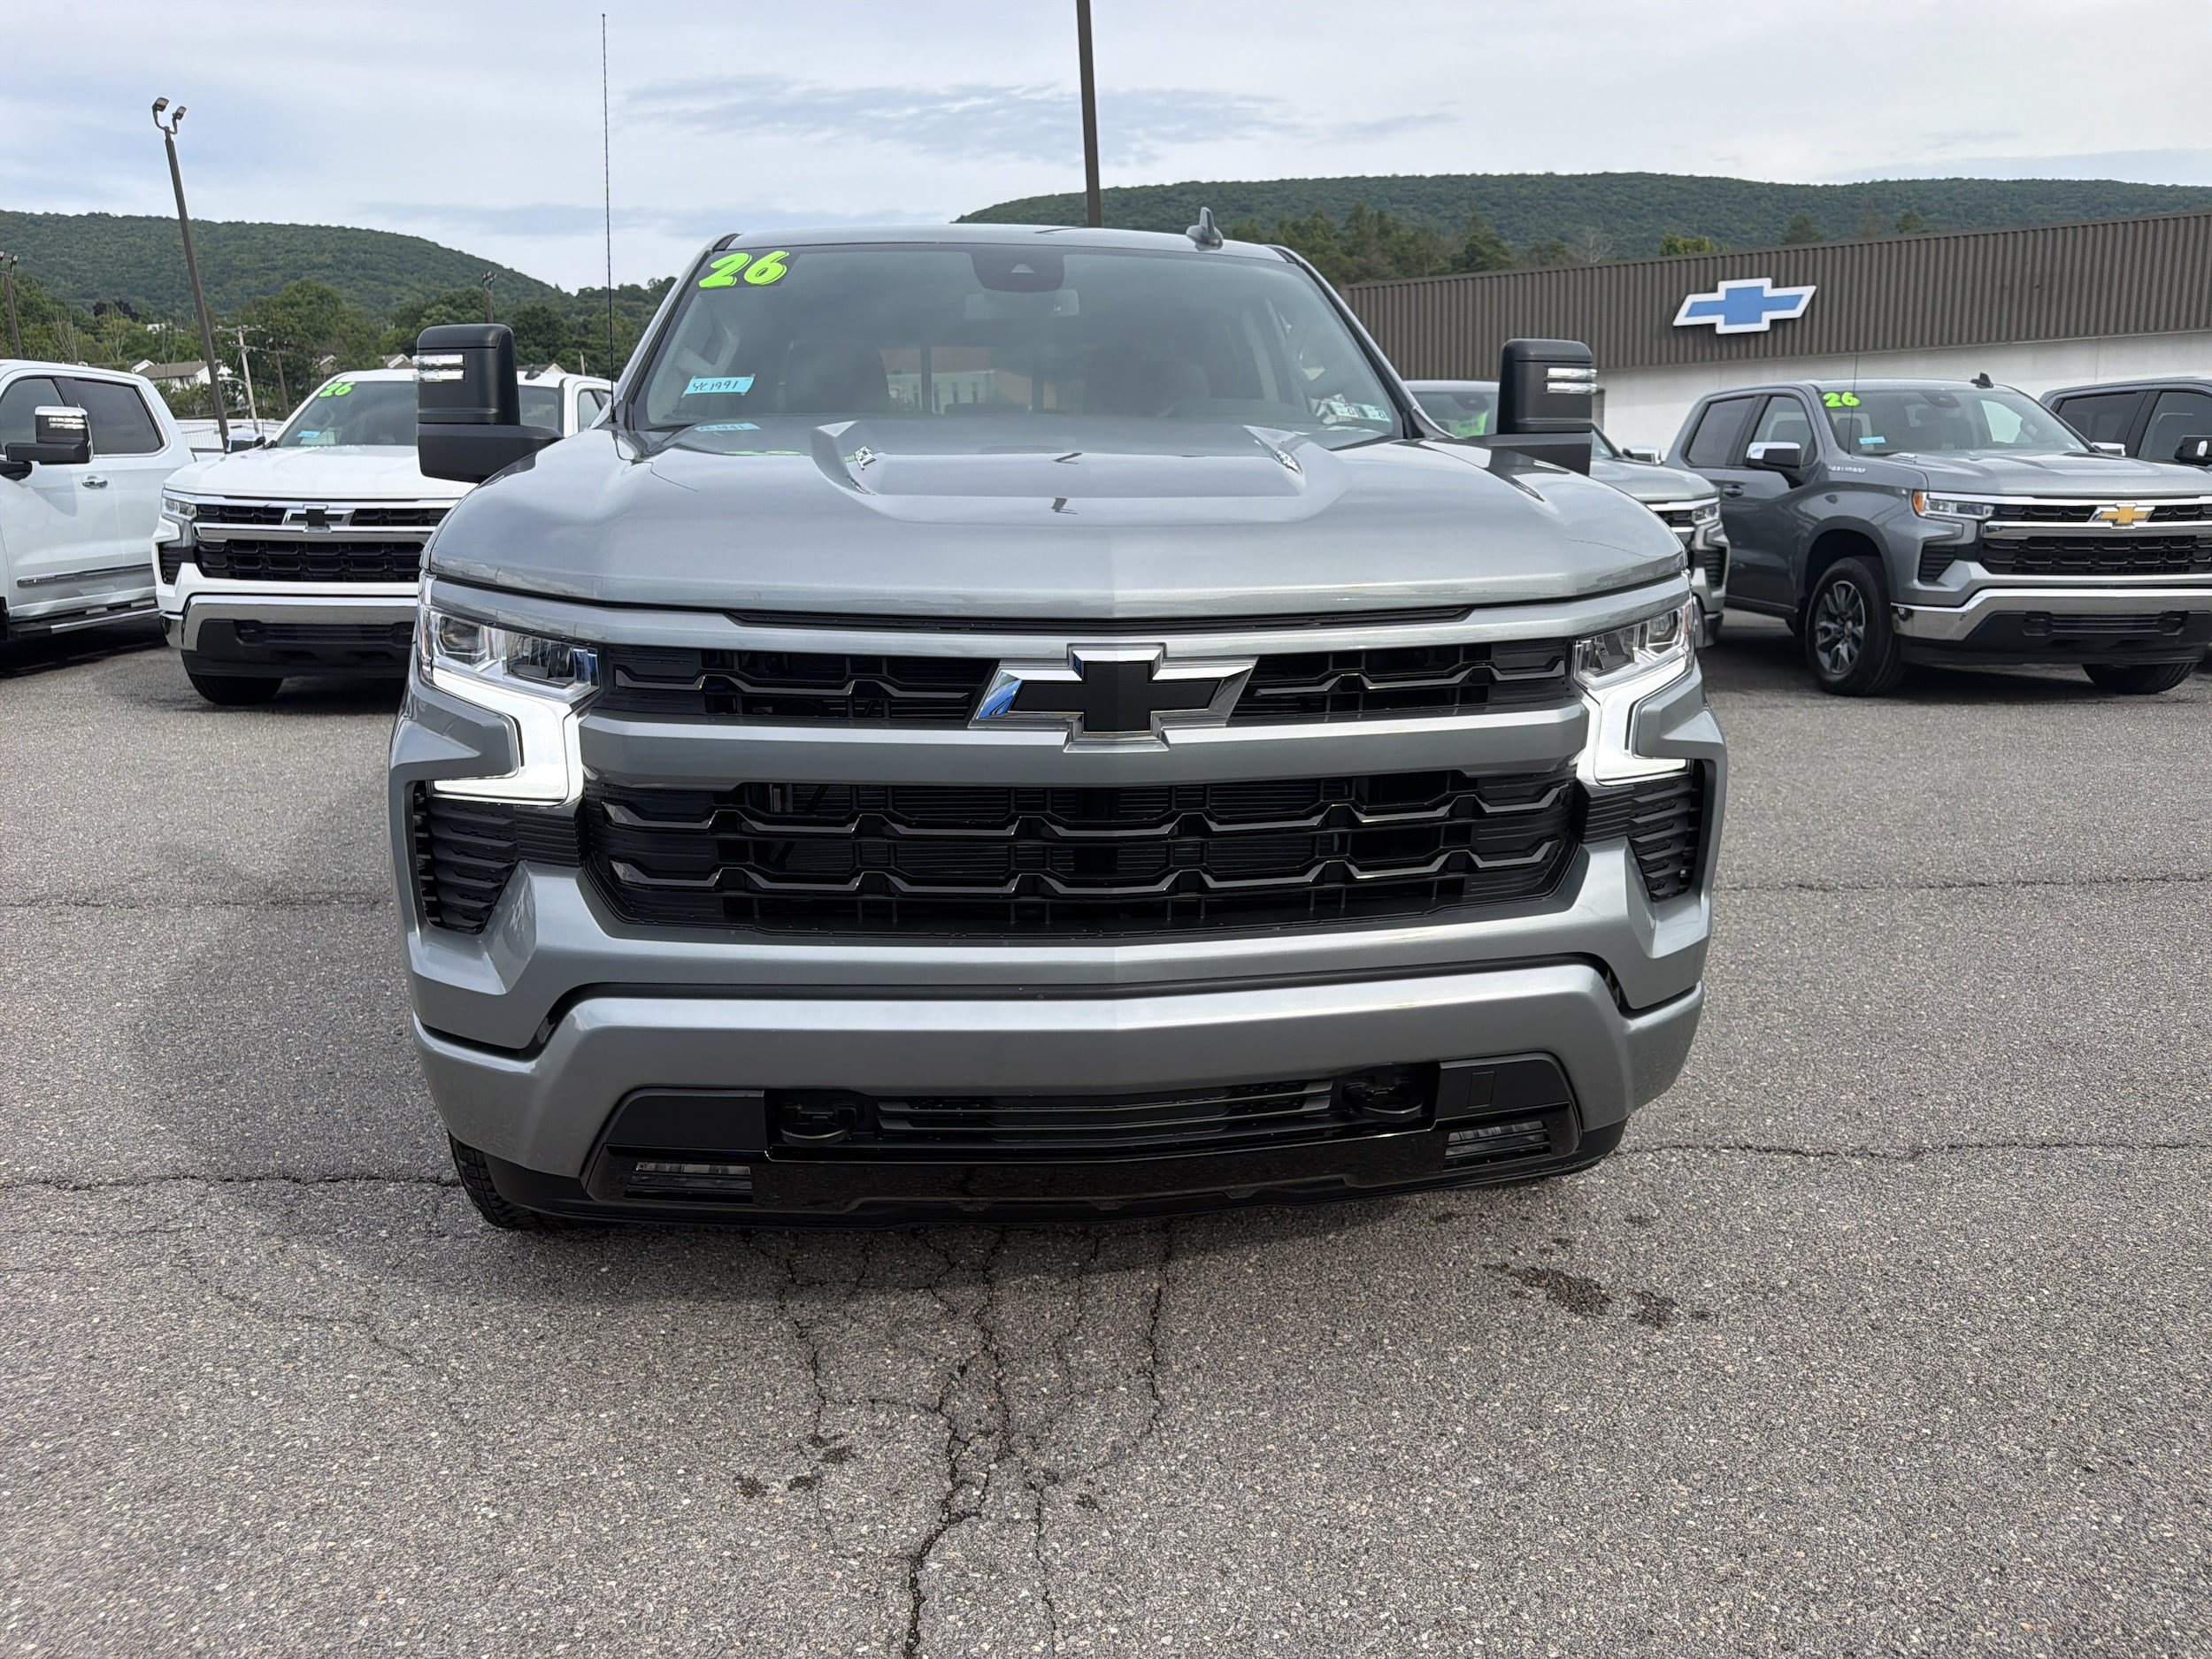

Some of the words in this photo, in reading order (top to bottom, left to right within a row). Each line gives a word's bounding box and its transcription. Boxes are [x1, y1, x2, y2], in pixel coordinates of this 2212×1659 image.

[698, 250, 790, 288] 26
[319, 381, 356, 397] 26
[1823, 391, 1861, 407] 26
